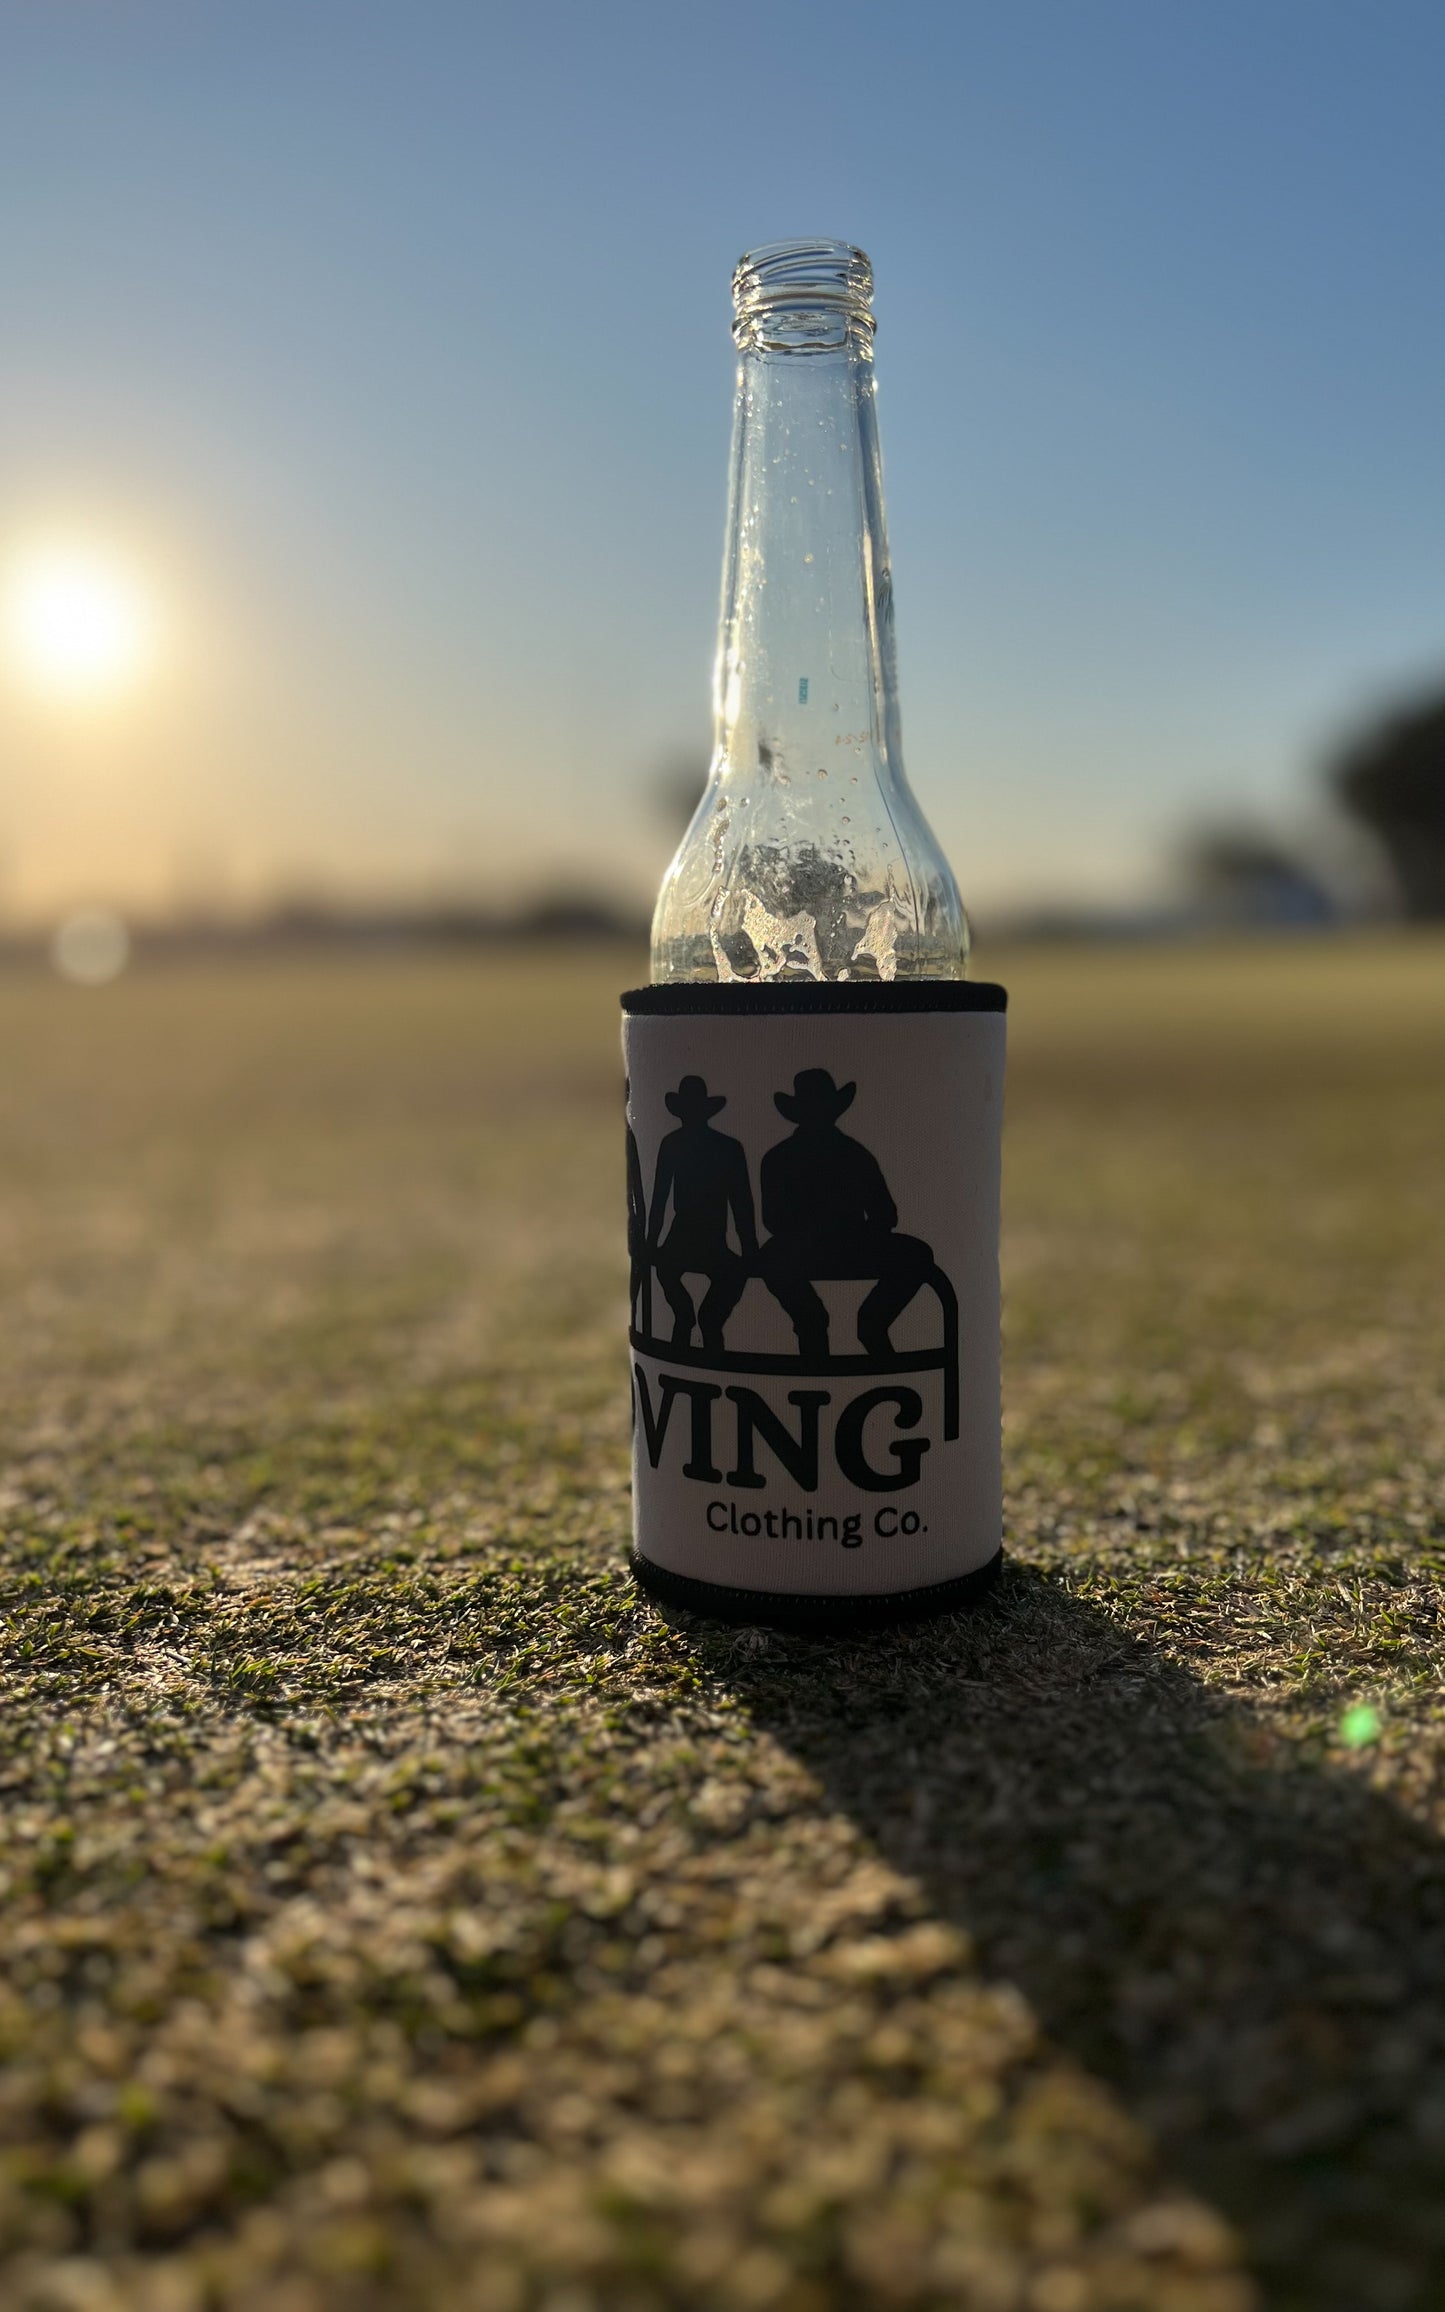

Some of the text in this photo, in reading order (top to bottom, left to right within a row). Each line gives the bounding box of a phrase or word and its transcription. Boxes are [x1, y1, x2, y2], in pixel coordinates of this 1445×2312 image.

[632, 1362, 931, 1493] VING
[706, 1501, 928, 1549] Clothing Co.
